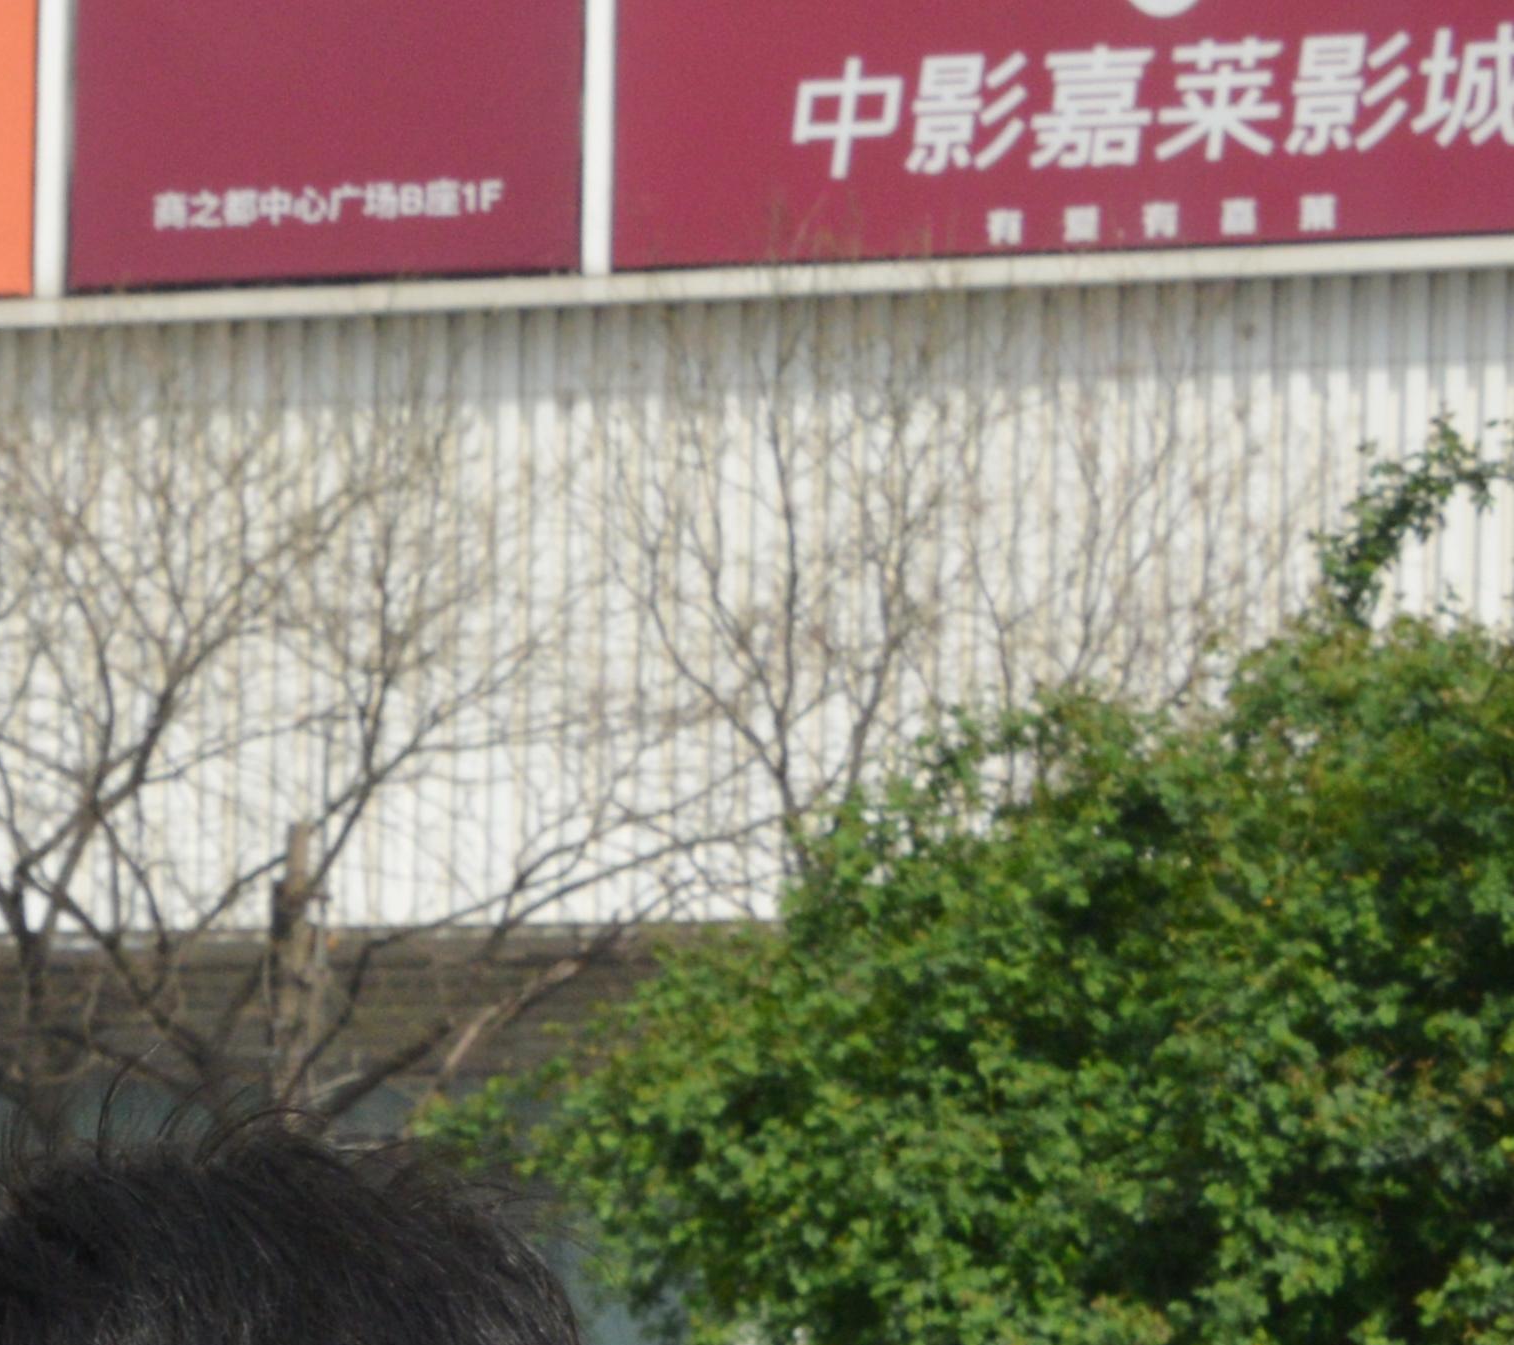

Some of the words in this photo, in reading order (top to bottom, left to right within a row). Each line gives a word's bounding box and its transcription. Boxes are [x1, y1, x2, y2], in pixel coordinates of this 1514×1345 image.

[792, 23, 1514, 180] 中影嘉莱影城
